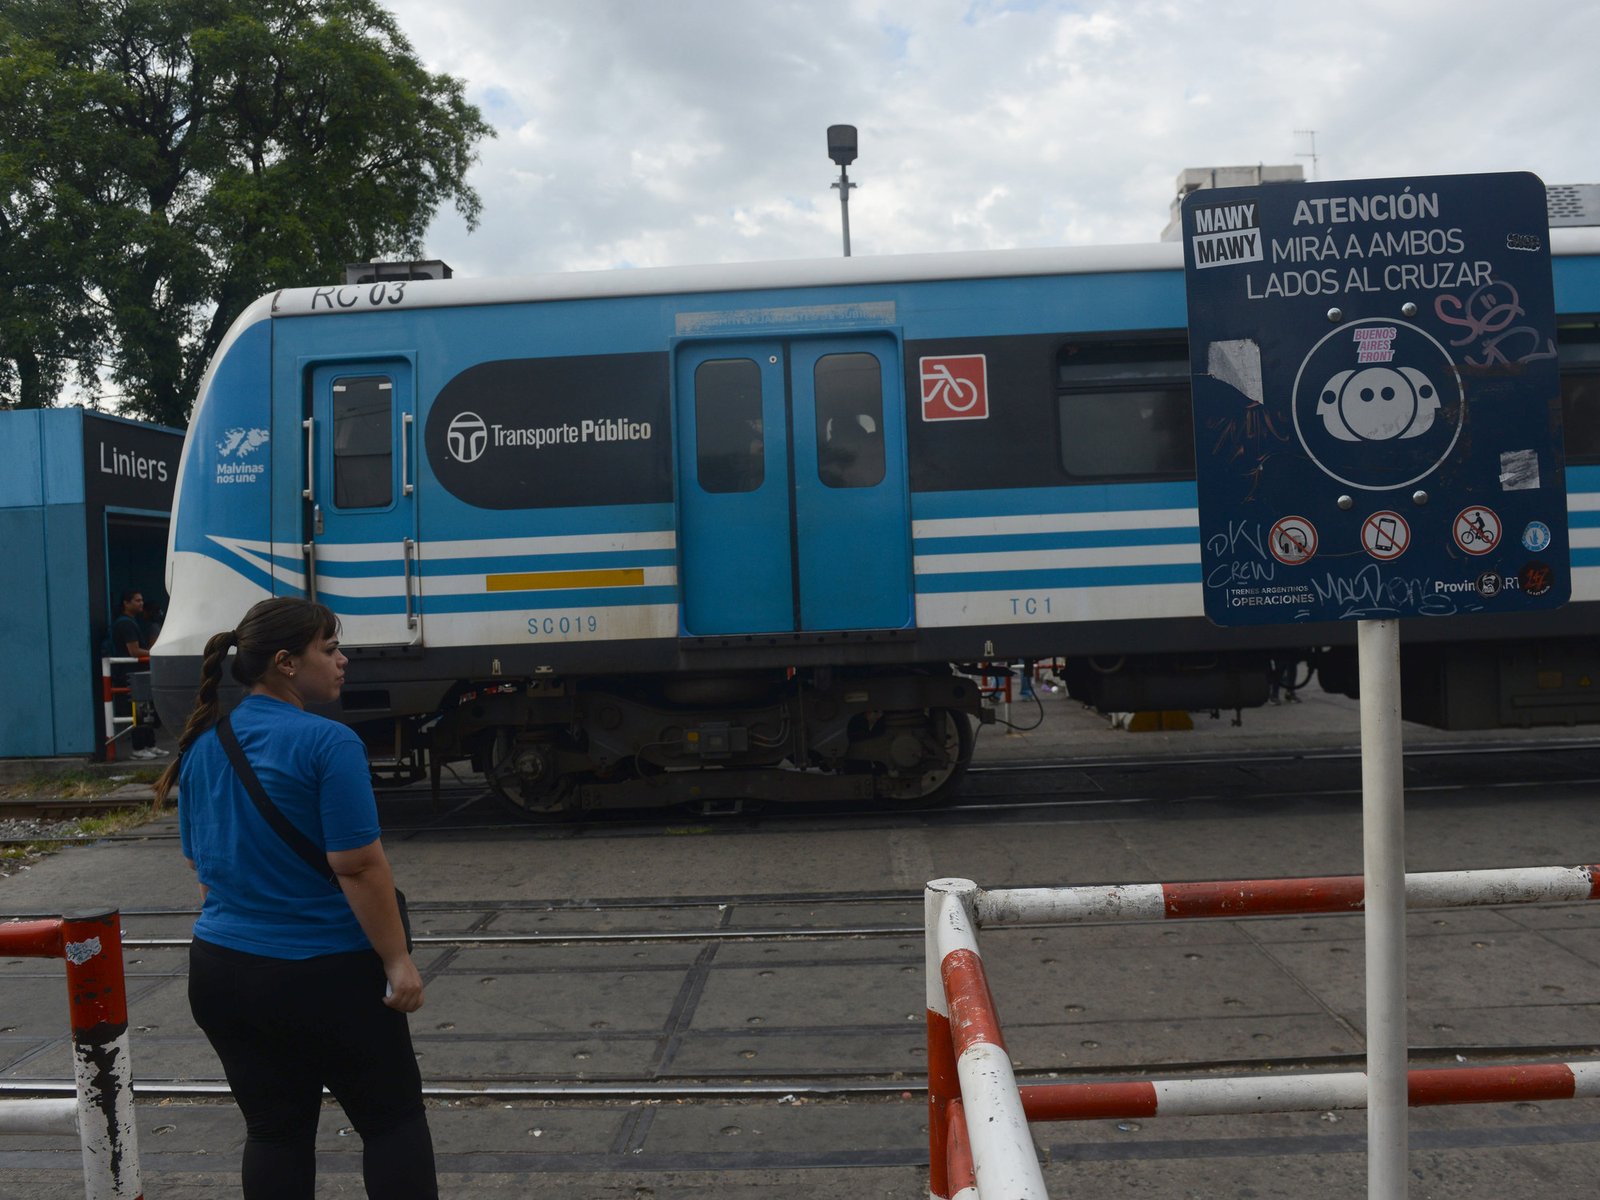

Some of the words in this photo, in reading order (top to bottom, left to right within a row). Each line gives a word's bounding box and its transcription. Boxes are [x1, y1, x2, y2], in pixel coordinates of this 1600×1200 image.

[1292, 185, 1440, 226] ATENCIÓN
[1195, 204, 1255, 233] MAWY
[1197, 233, 1256, 264] MAWY
[1271, 227, 1341, 264] MIRÁ
[1344, 232, 1365, 259] A
[1368, 228, 1466, 258] AMBOS
[1246, 268, 1341, 300] LADOS
[1344, 266, 1381, 294] AL
[1384, 261, 1494, 291] CRUZAR
[311, 285, 359, 310] RC
[368, 282, 407, 306] 03
[1355, 328, 1396, 341] BUENOS
[1359, 340, 1390, 351] AIRES
[1360, 351, 1394, 362] FRONT
[100, 441, 168, 482] Liniers
[216, 461, 264, 476] Malvinas
[216, 474, 235, 484] nos
[235, 474, 257, 484] une
[1231, 588, 1260, 596] TRENES
[1261, 586, 1309, 595] ARGENTINOS
[1434, 579, 1476, 593] Provin
[1010, 596, 1051, 616] TC1
[1231, 593, 1315, 608] OPERACIONES
